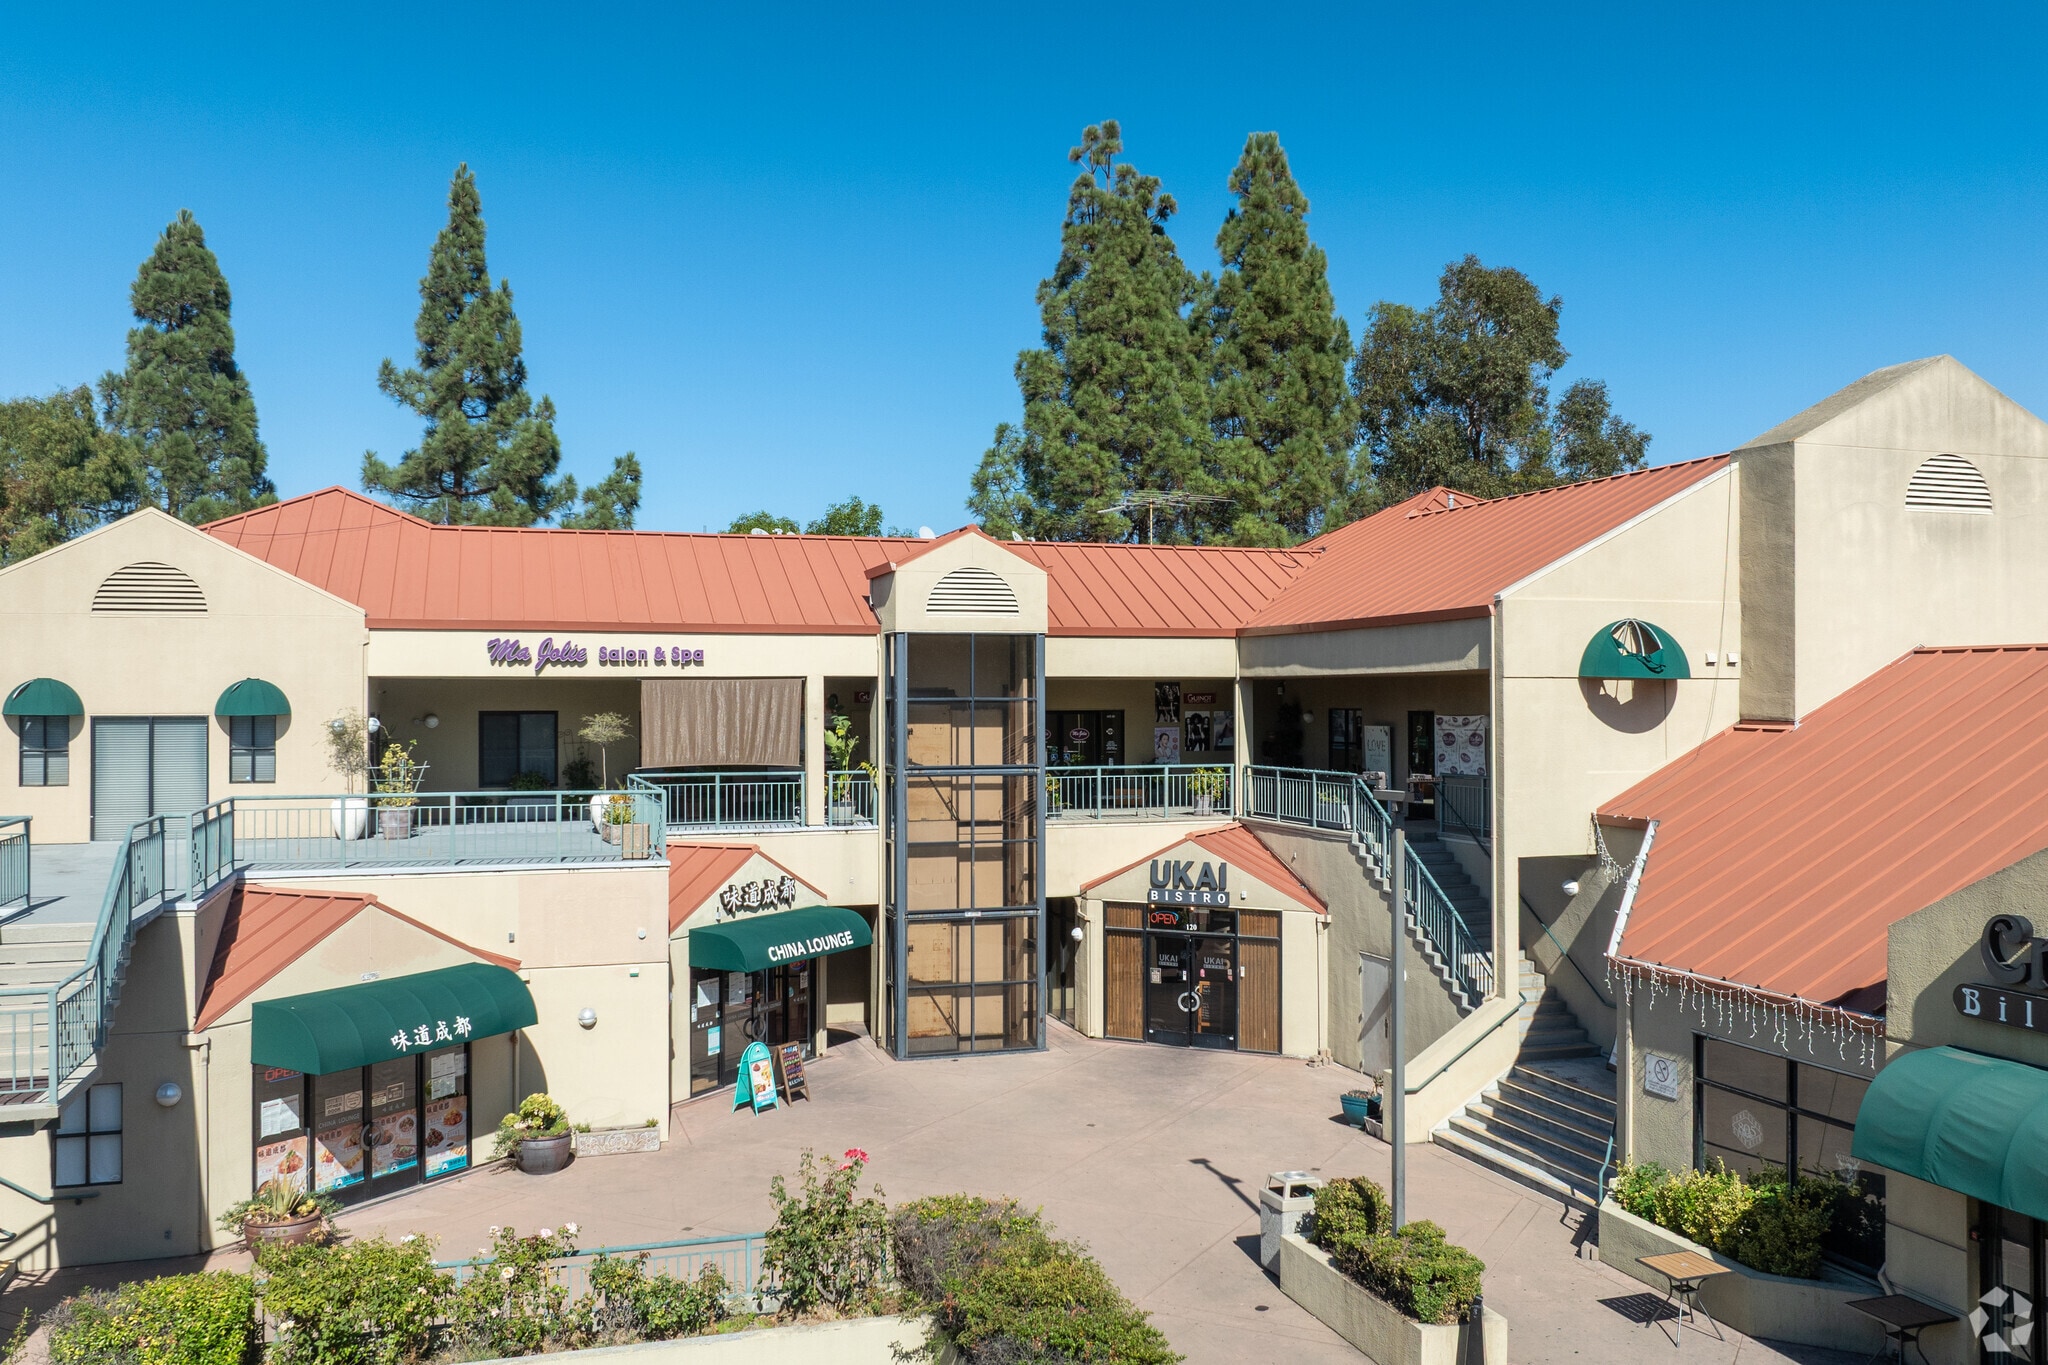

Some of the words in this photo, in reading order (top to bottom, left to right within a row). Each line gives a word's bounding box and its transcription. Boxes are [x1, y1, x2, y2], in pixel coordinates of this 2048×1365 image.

[487, 637, 530, 662] Ma
[535, 637, 587, 671] Jolie
[598, 646, 649, 661] Salon
[653, 646, 667, 661] &
[671, 646, 705, 664] Spa
[1367, 738, 1386, 752] LOVE
[1150, 859, 1227, 891] UKAI
[722, 876, 797, 912] 味道成都
[1150, 890, 1226, 904] BISTRO
[1150, 912, 1177, 925] OPEN
[1186, 923, 1198, 931] 120
[768, 940, 807, 962] CHINA
[806, 930, 854, 953] LOUNGE
[1158, 953, 1178, 962] UKAI
[1203, 956, 1224, 965] UKAI
[390, 1016, 472, 1052] 味道成都
[318, 1120, 336, 1129] CHINA
[338, 1112, 360, 1124] LOUNGE
[1738, 1122, 1757, 1137] 805
